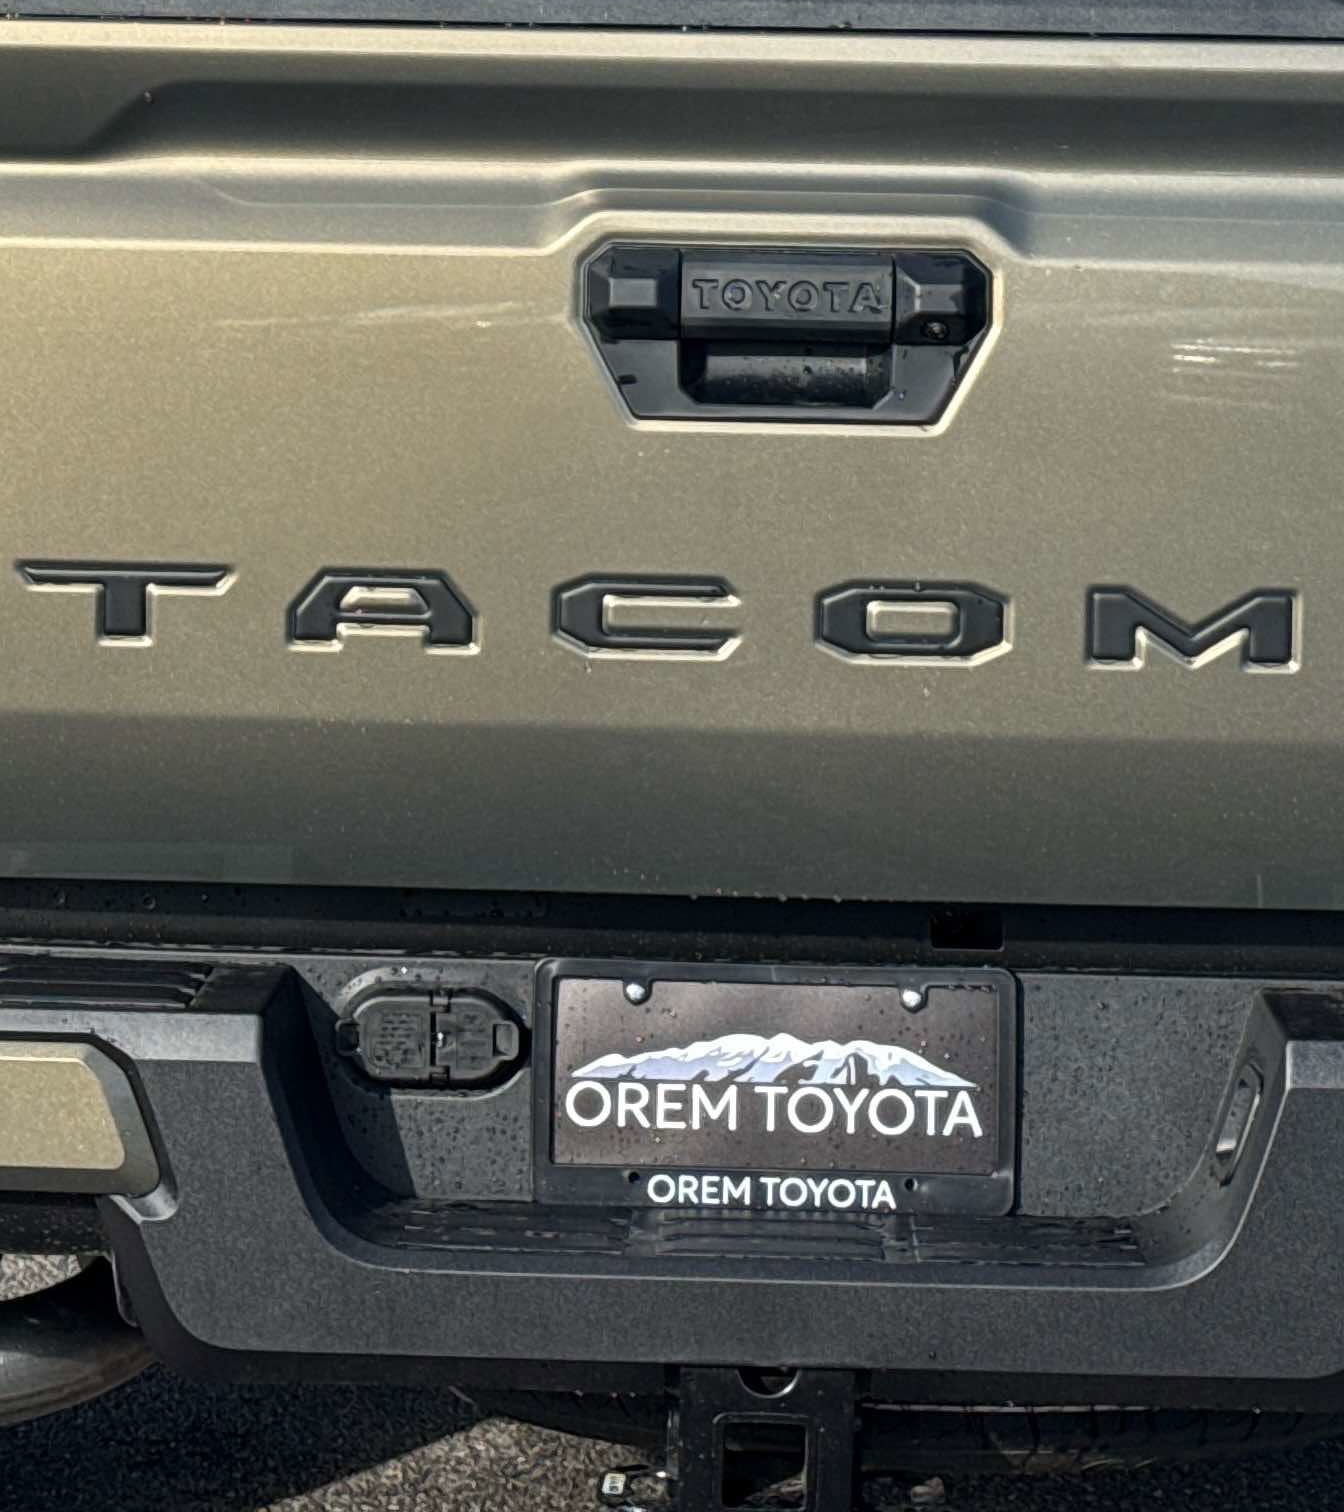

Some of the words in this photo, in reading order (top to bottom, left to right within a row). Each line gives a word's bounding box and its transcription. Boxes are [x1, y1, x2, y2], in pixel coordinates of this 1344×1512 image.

[690, 277, 887, 314] TOYOTA
[565, 1081, 738, 1131] OREM
[755, 1085, 984, 1138] TOYOTA
[647, 1174, 750, 1205] OREM
[760, 1176, 896, 1209] TOYOTA
